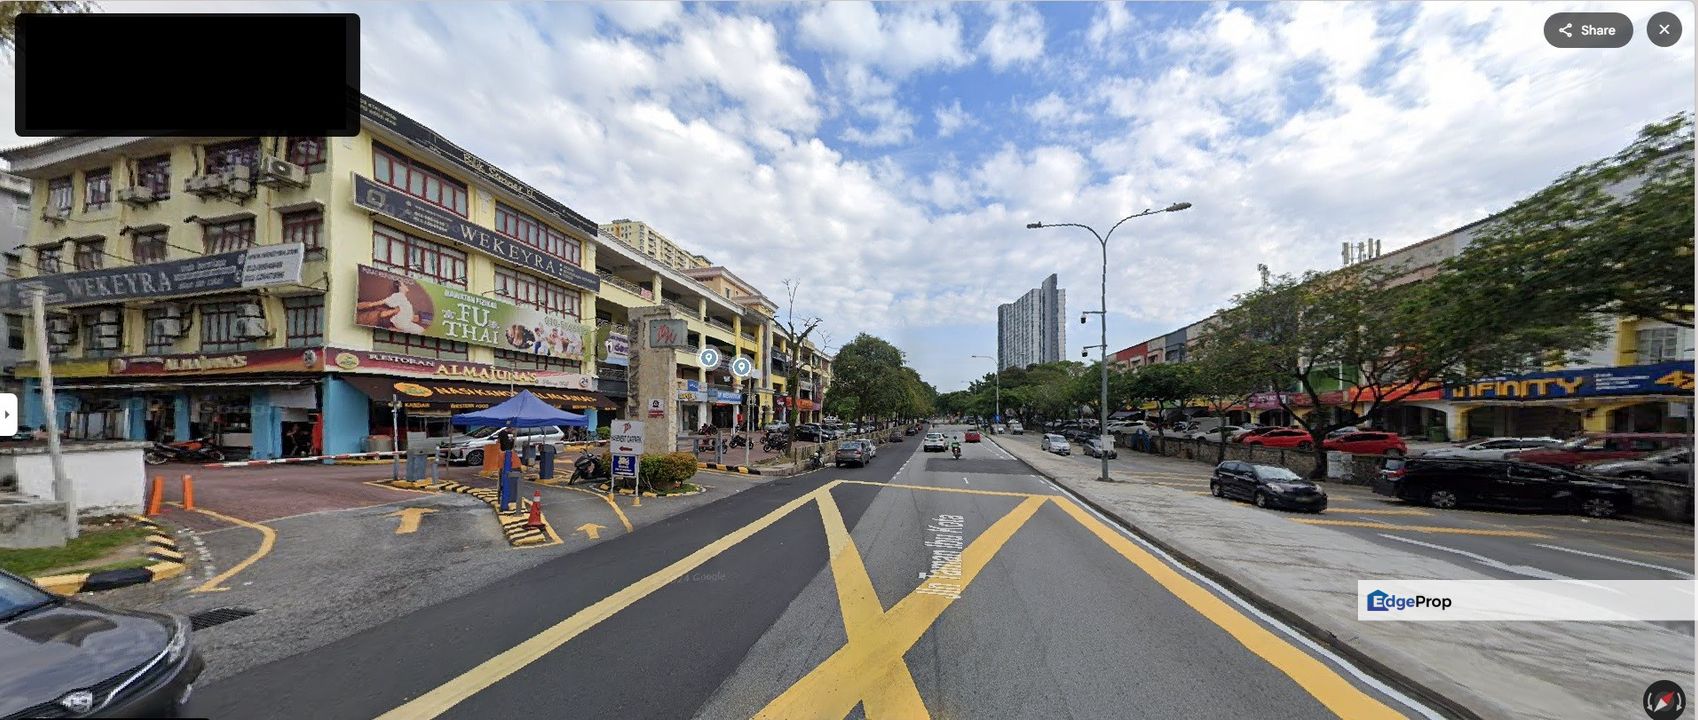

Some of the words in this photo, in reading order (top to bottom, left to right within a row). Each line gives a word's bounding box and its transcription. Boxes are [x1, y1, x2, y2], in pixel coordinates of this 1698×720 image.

[460, 223, 555, 274] WEKEYRA
[456, 302, 490, 328] FU
[441, 320, 499, 345] THAI
[368, 353, 434, 367] RESTORAN
